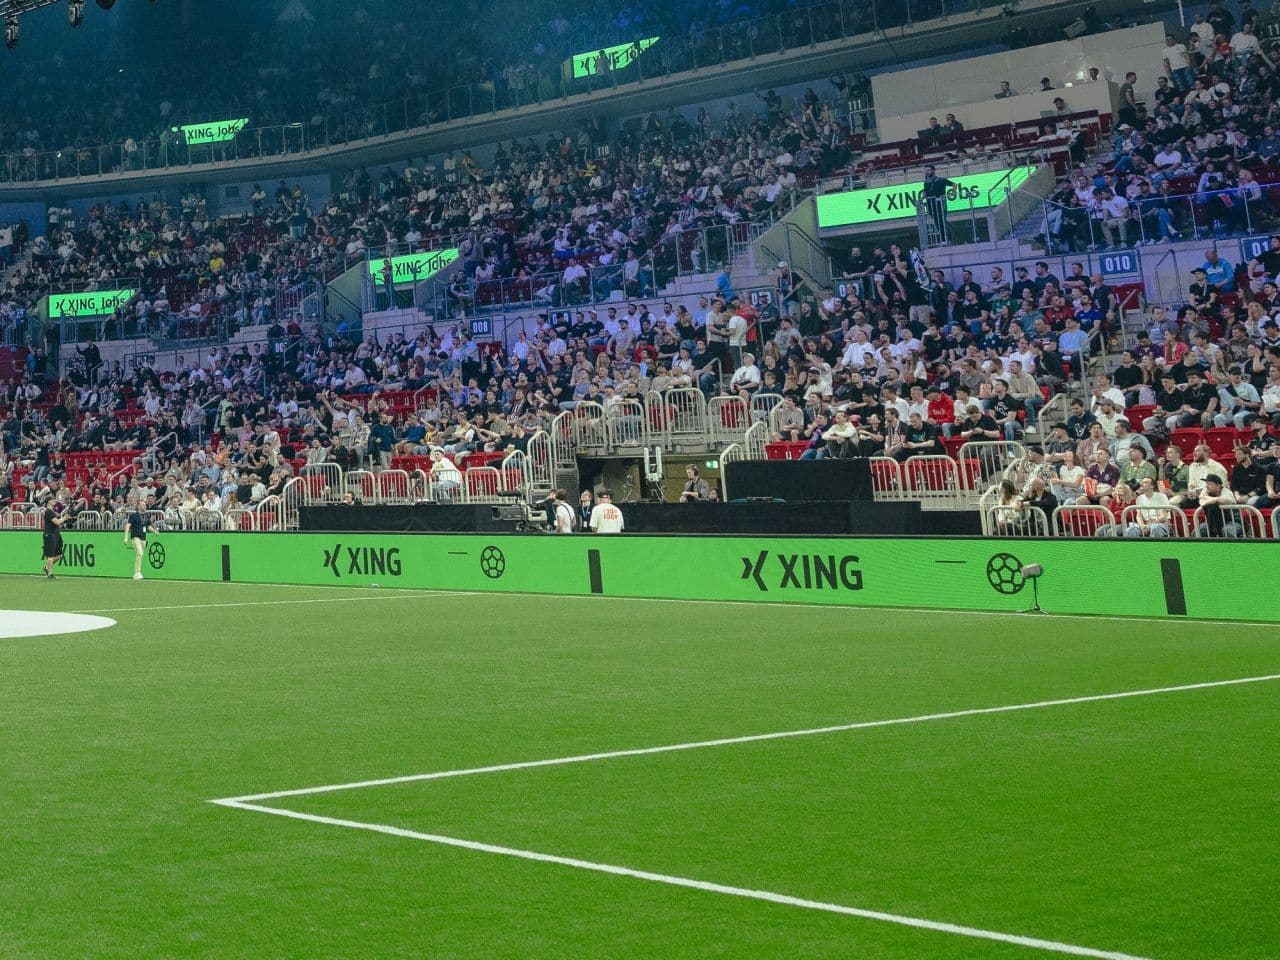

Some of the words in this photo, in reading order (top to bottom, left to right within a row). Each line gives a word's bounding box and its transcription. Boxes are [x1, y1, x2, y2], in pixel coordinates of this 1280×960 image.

[187, 128, 213, 140] XING
[217, 125, 239, 137] Jobs
[1252, 242, 1271, 258] 01
[395, 260, 422, 277] XING
[1105, 255, 1131, 271] 010
[68, 298, 96, 311] XING
[101, 295, 124, 310] Jobs
[472, 321, 488, 333] 008
[347, 546, 402, 576] XING
[777, 554, 864, 591] XING
